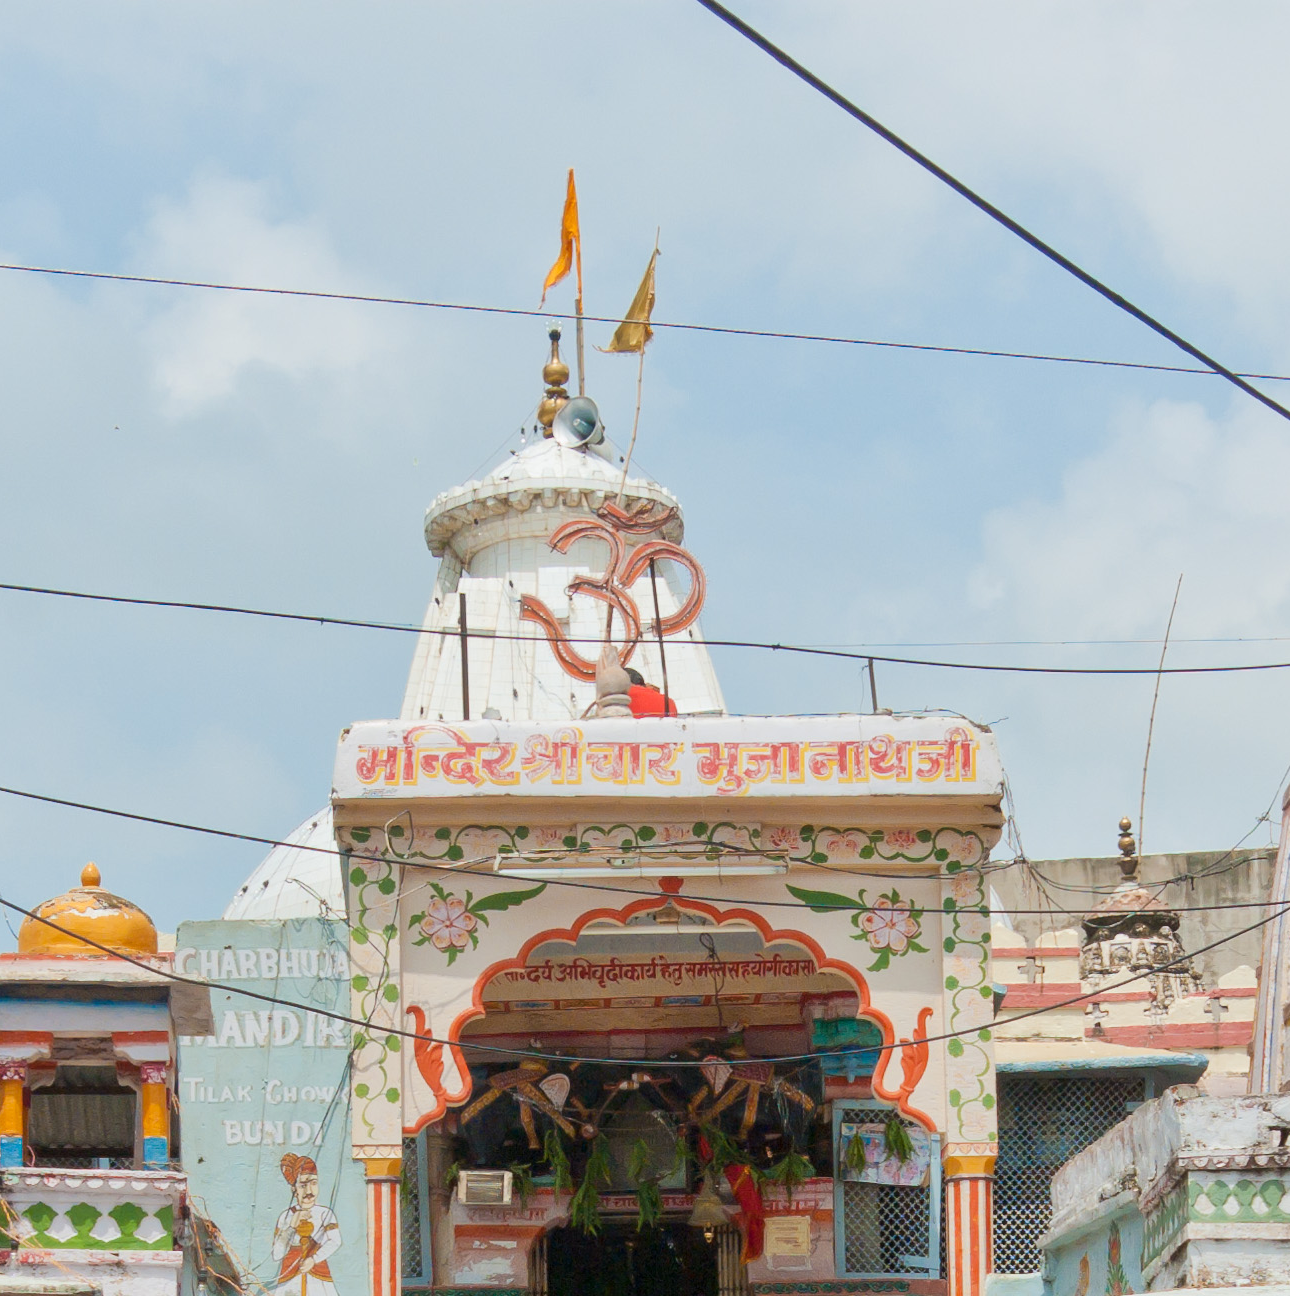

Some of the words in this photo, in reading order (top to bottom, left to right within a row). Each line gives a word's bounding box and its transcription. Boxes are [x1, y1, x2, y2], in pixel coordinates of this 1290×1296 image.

[357, 725, 519, 787] मन्दिर
[176, 947, 350, 980] CHARBHUJA
[180, 1010, 347, 1047] ANDIR
[223, 1119, 325, 1147] BUNDI
